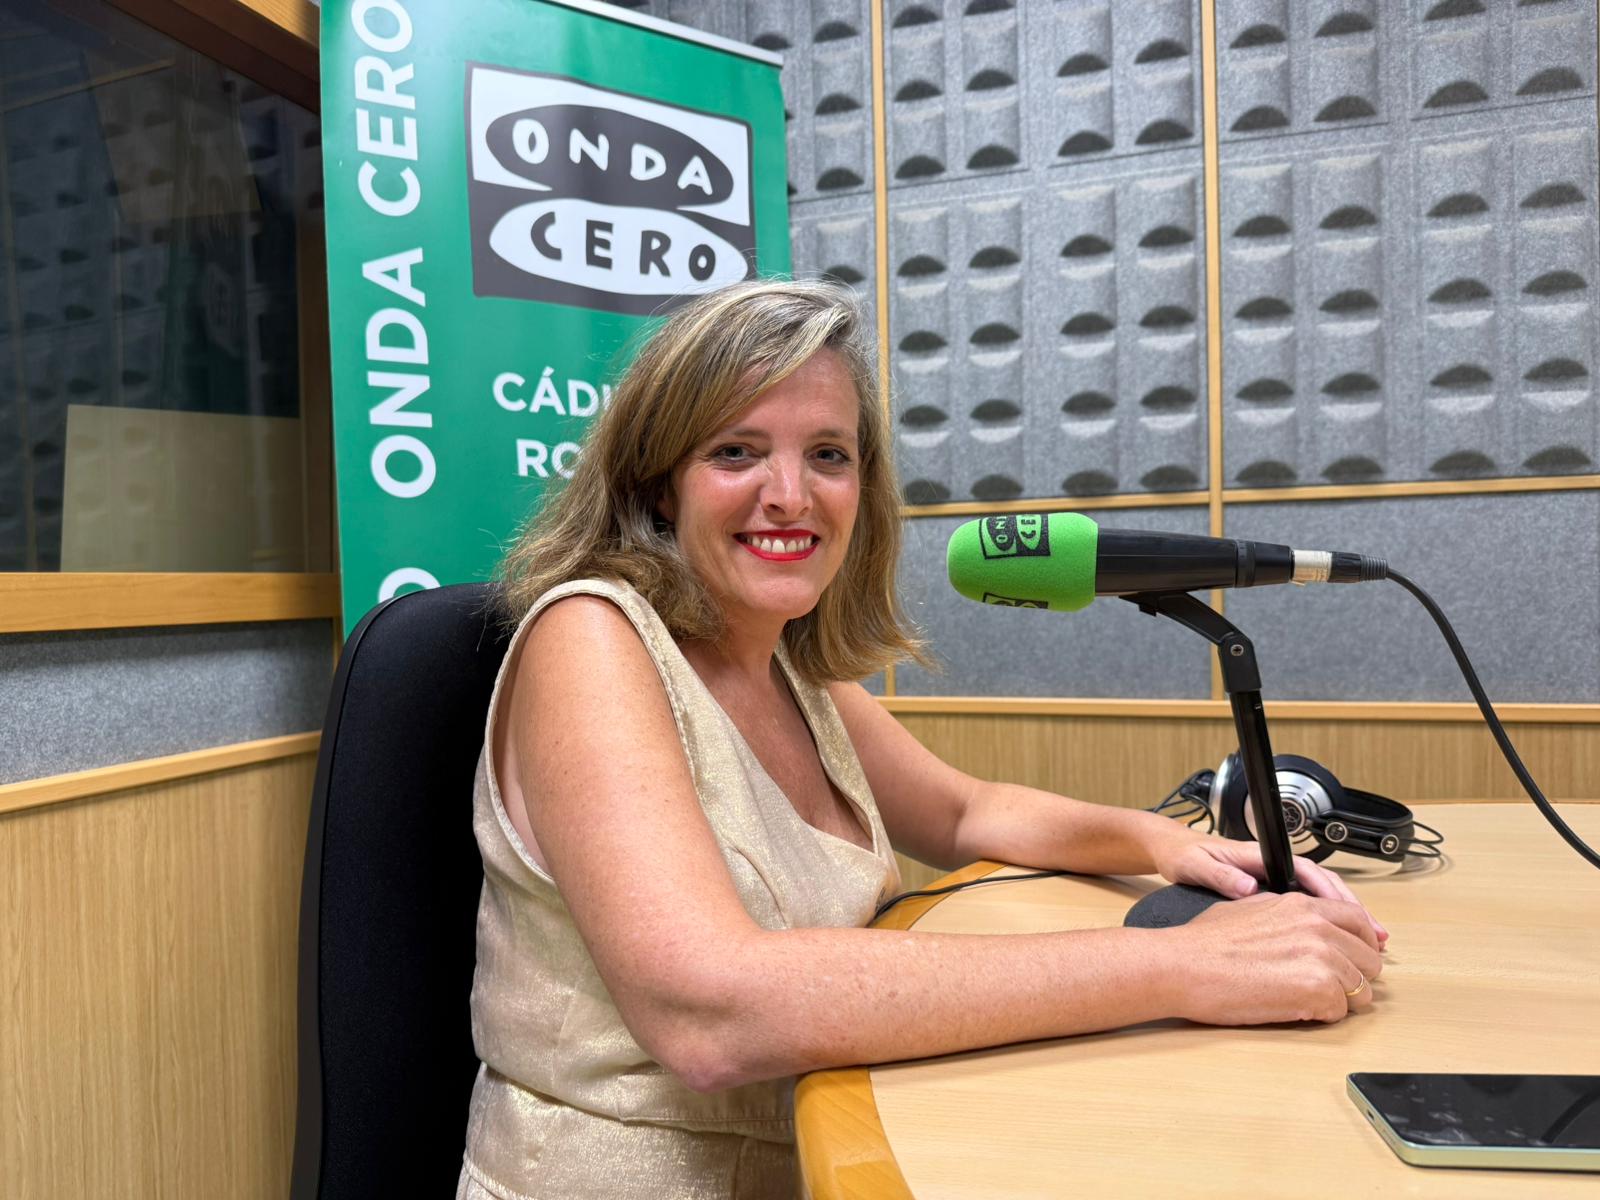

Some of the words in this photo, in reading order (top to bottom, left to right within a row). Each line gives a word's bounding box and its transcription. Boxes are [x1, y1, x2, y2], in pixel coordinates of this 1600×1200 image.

[351, 0, 421, 216] CERO
[512, 118, 713, 195] ONDA
[530, 211, 716, 282] CERO
[362, 247, 437, 498] ONDA
[492, 366, 620, 417] CÁDI
[516, 438, 583, 479] RO
[995, 516, 1008, 543] ON
[1020, 519, 1036, 539] CE
